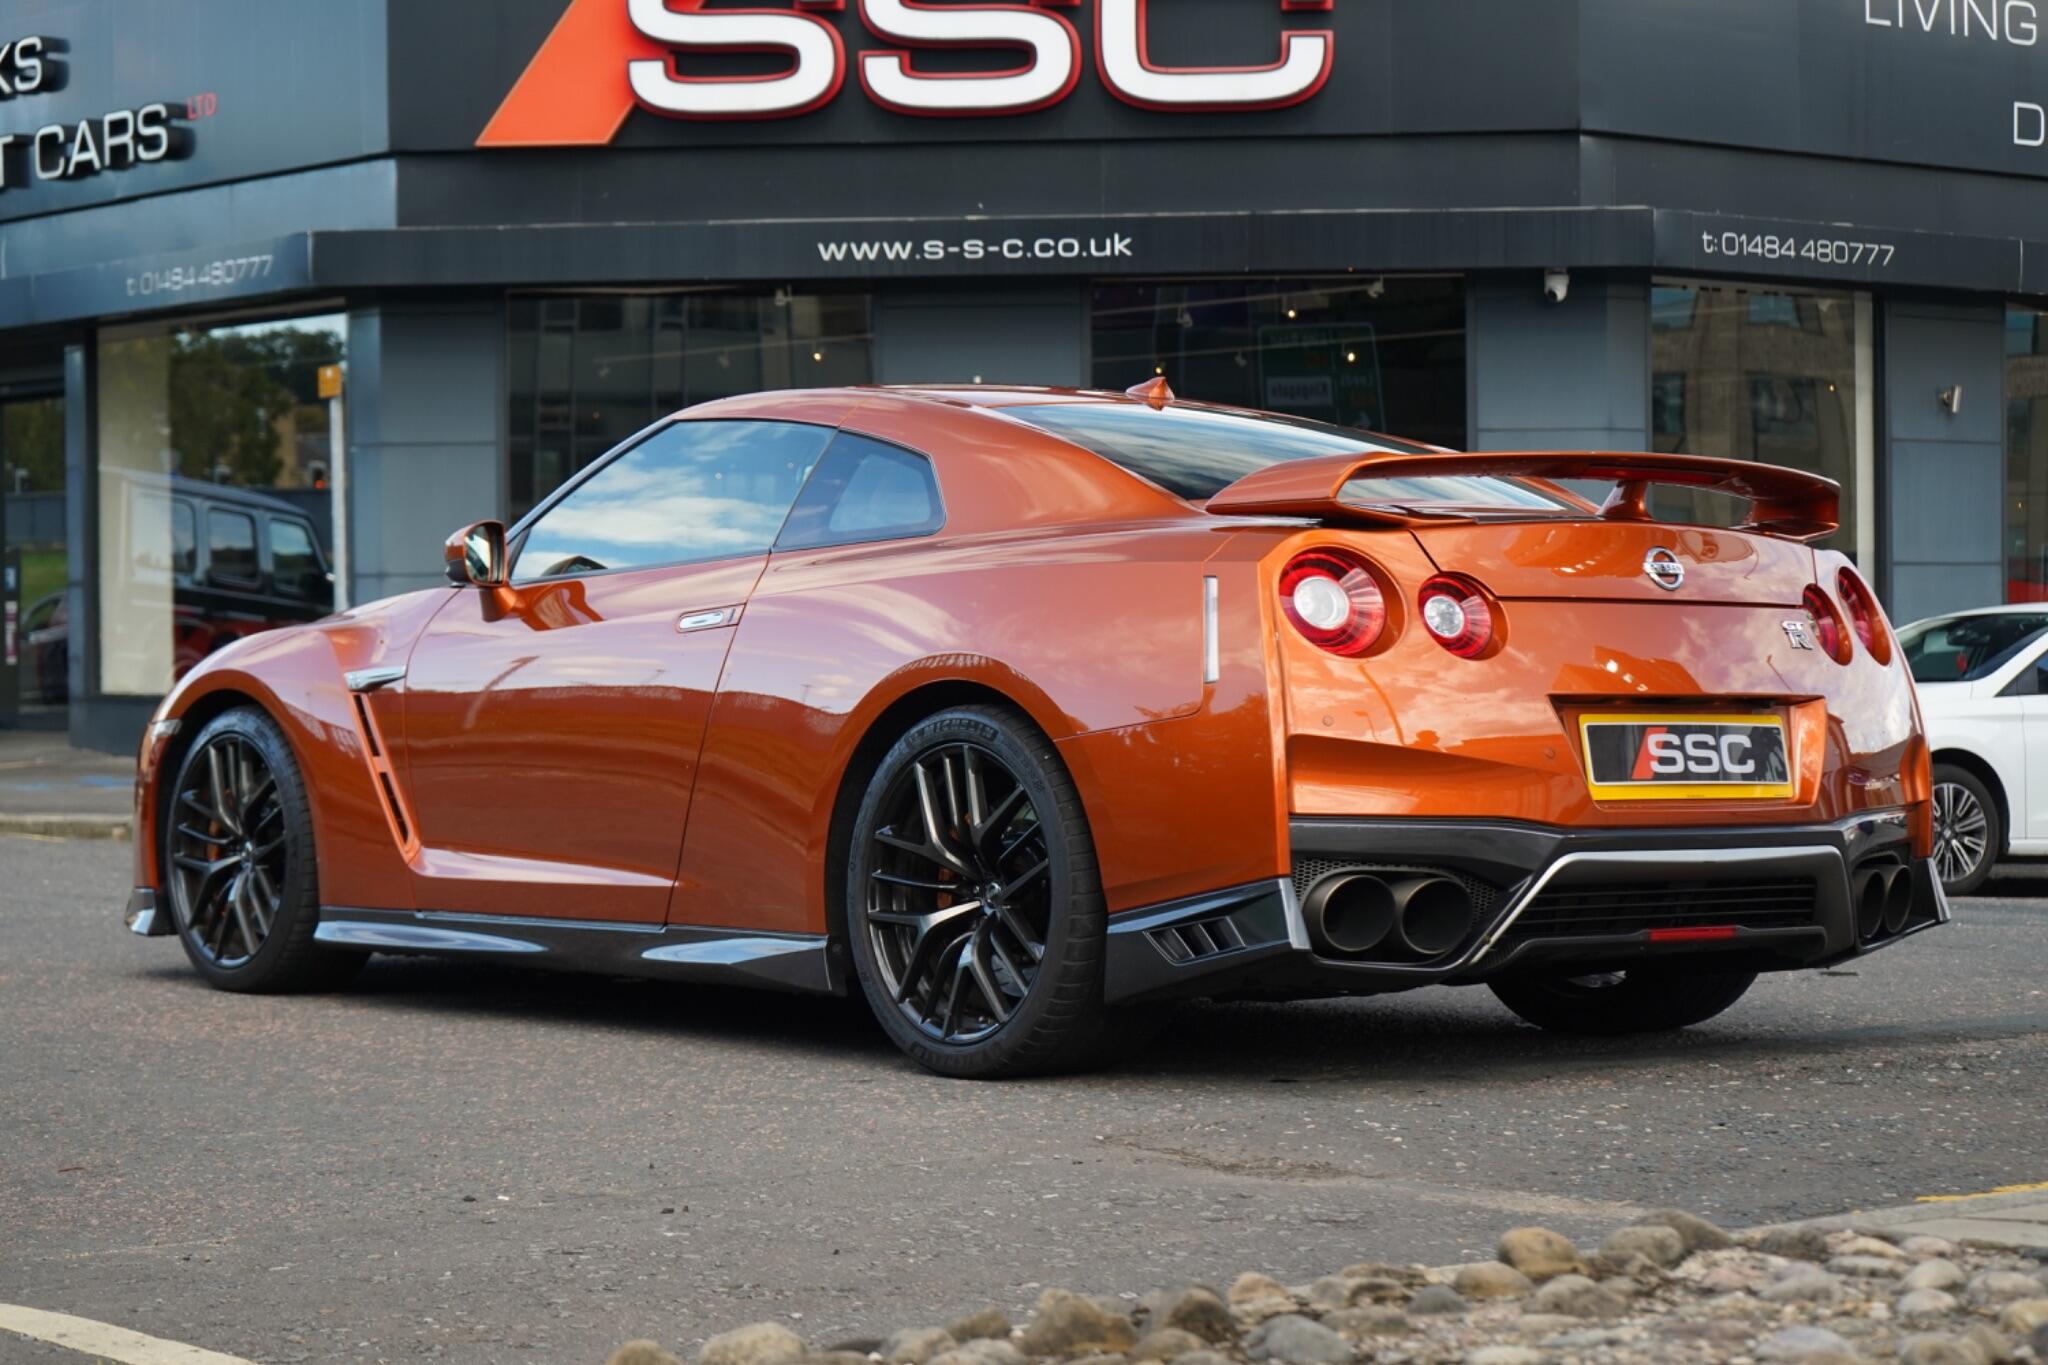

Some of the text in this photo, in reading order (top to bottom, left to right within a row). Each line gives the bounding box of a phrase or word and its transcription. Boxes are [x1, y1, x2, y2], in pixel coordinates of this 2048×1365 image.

[1864, 0, 2037, 46] LIVING
[628, 0, 1333, 116] SSC
[186, 92, 217, 121] LTD
[34, 103, 169, 180] CARS
[817, 232, 1133, 262] www.s-s-c.co.uk
[1648, 733, 1756, 774] SSC
